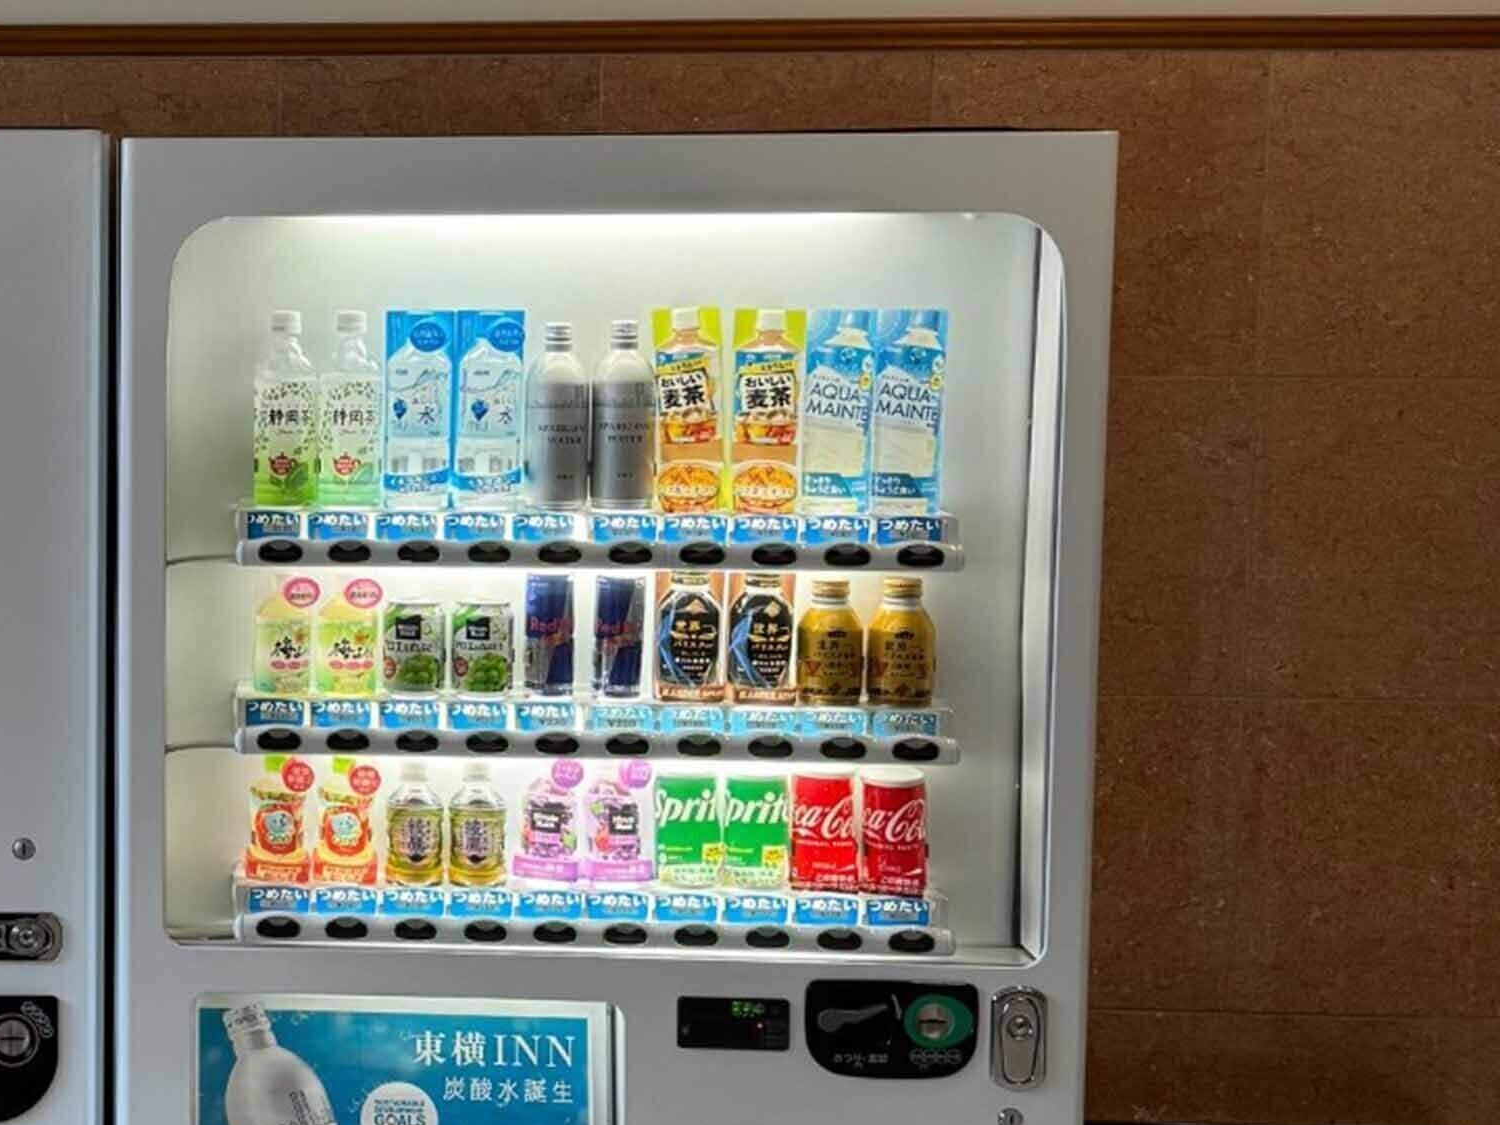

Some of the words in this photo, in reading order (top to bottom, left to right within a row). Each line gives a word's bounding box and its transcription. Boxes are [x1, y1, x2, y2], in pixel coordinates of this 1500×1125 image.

[663, 385, 705, 409] 麦茶
[747, 387, 792, 409] 麦茶
[810, 382, 860, 402] AQUA
[879, 382, 930, 403] AQUA
[310, 514, 366, 525] つめたい
[379, 515, 436, 526] つめたい
[448, 515, 503, 527] つめたい
[514, 516, 574, 527] つめたい
[598, 516, 656, 528] つめたい
[665, 517, 726, 528] つめたい
[738, 518, 797, 529] つめたい
[806, 519, 868, 530] つめたい
[880, 519, 940, 531] つめたい
[248, 701, 302, 712] つめたい
[313, 702, 370, 713] つめたい
[384, 702, 439, 714] つめたい
[452, 704, 506, 716] つめたい
[520, 705, 574, 717] つめたい
[252, 889, 308, 900] つめたい
[318, 889, 375, 901] つめたい
[386, 890, 443, 902] つめたい
[453, 892, 510, 903] つめたい
[523, 893, 579, 905] つめたい
[590, 895, 646, 906] つめたい
[658, 896, 716, 907] つめたい
[730, 897, 786, 908] つめたい
[798, 899, 857, 911] つめたい
[870, 900, 927, 912] つめたい
[412, 1029, 577, 1067] 東横INN
[443, 1076, 574, 1104] 炭酸水誕生
